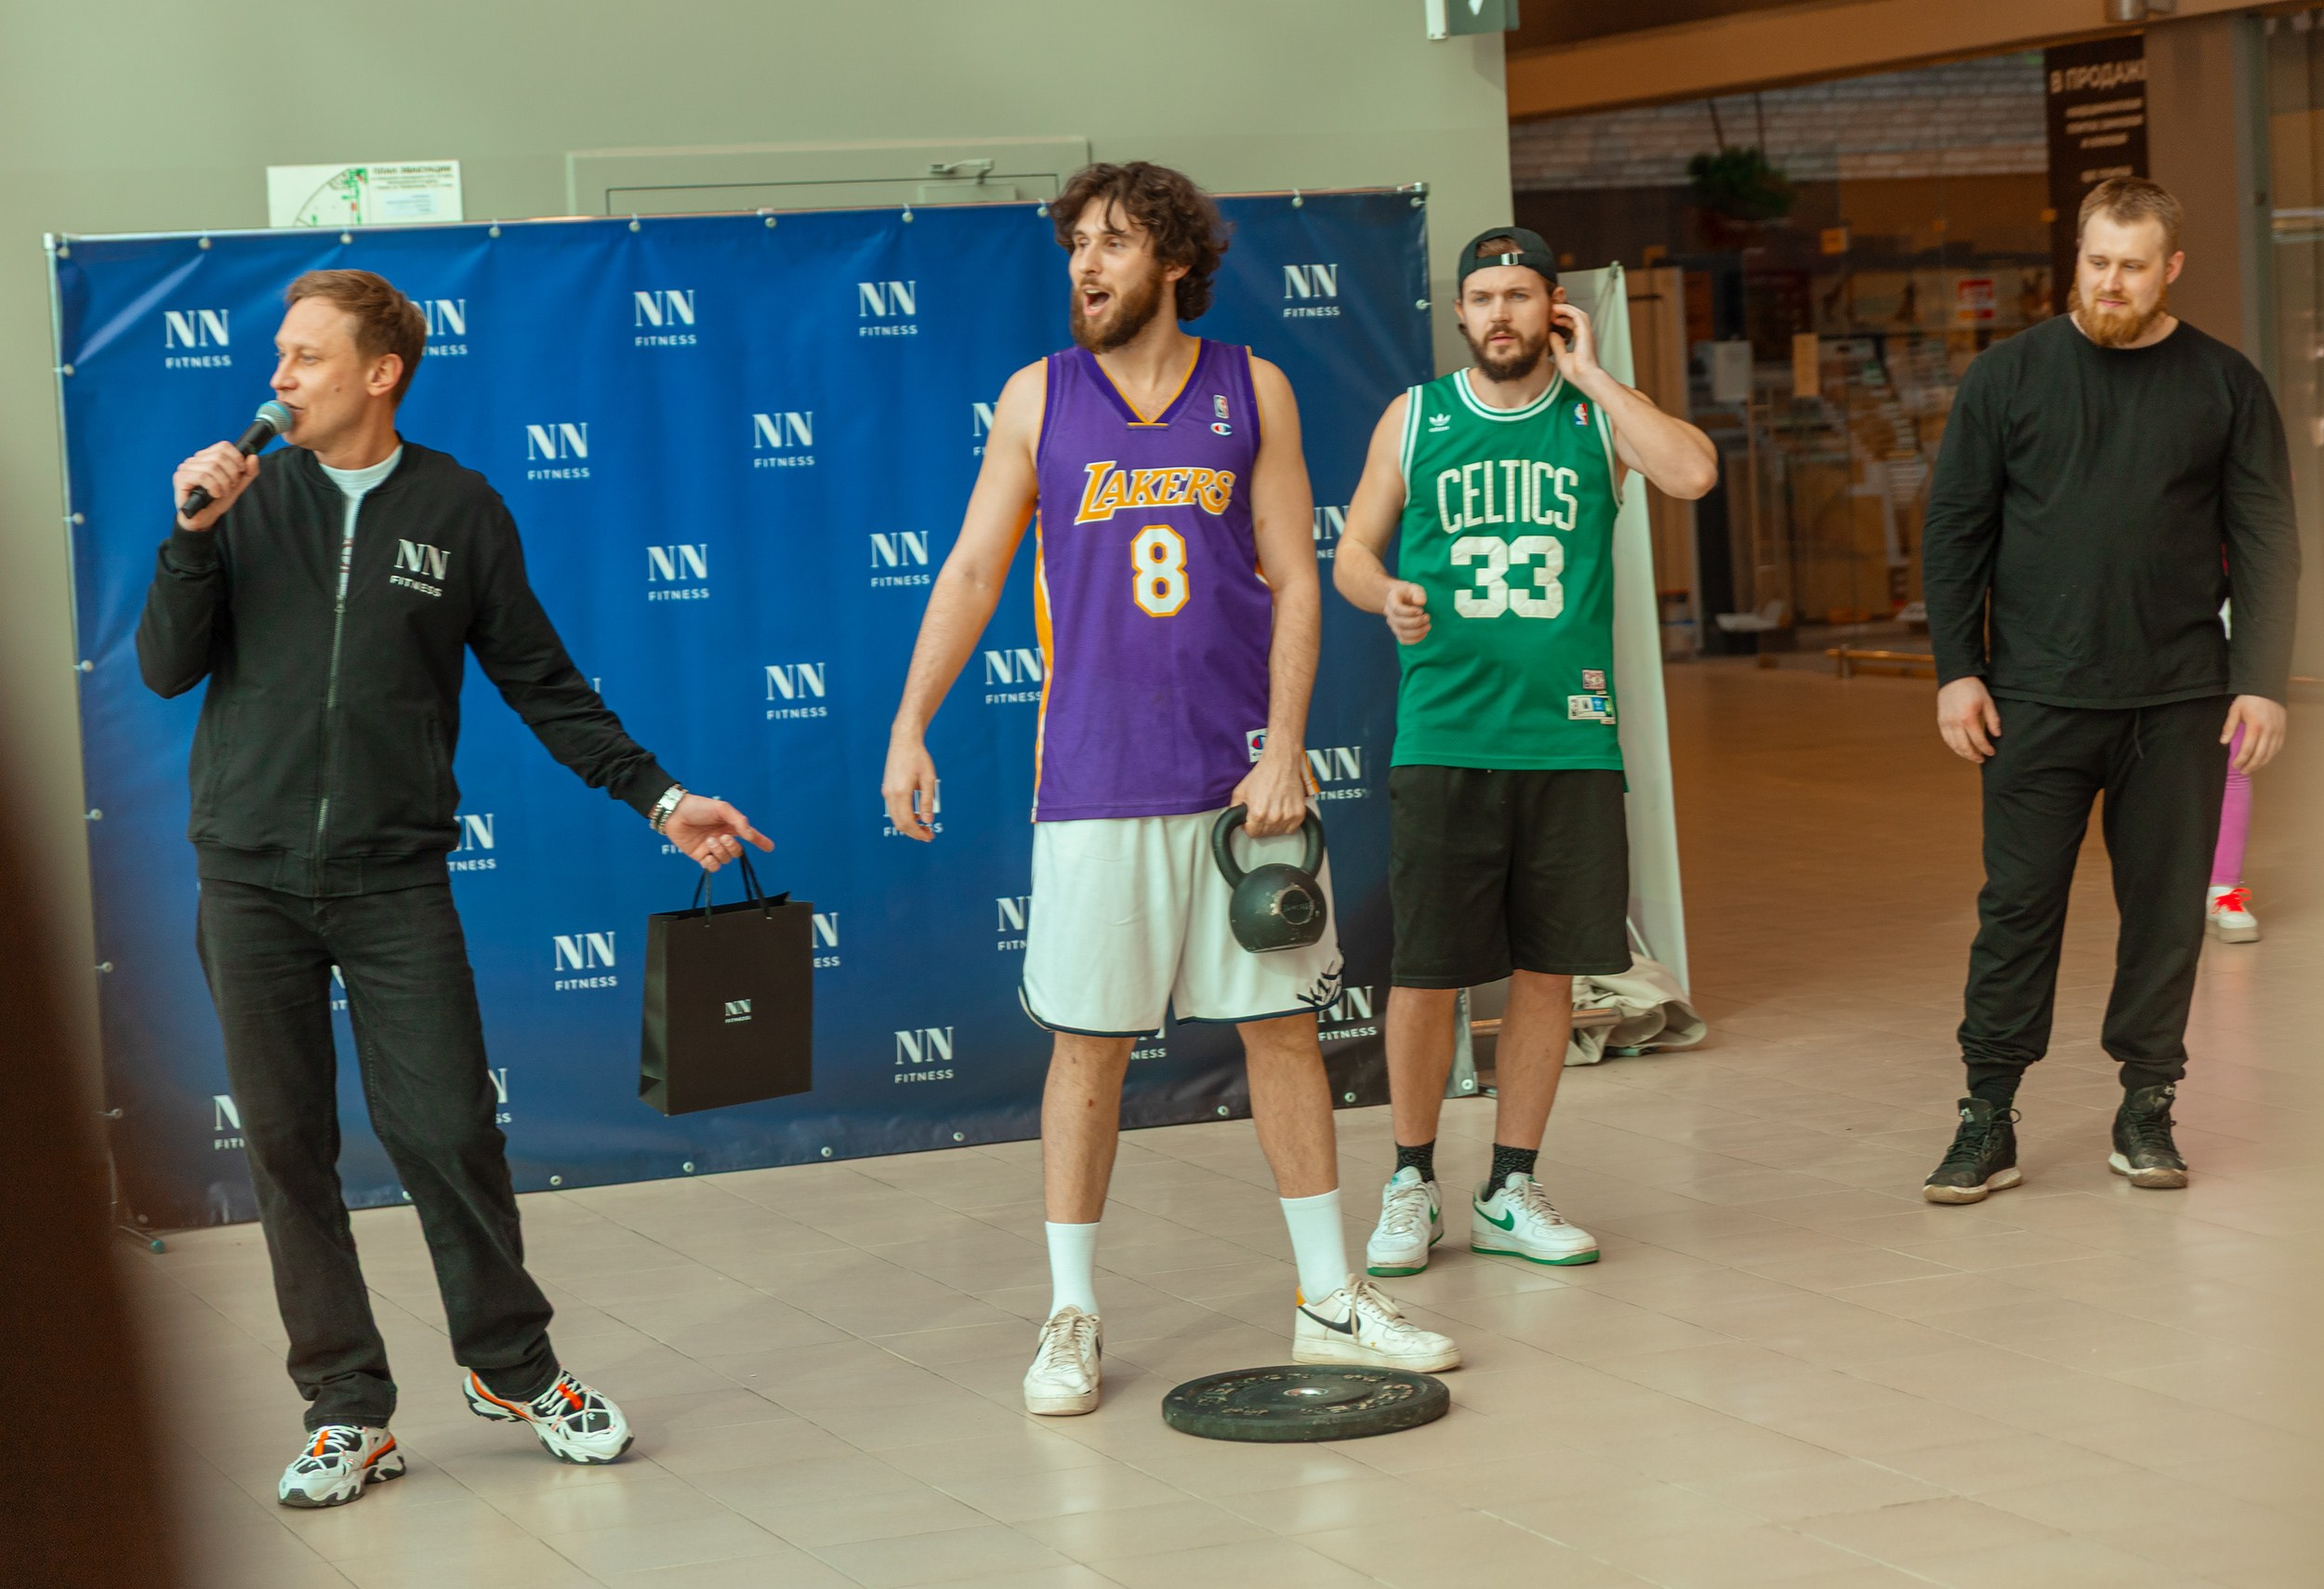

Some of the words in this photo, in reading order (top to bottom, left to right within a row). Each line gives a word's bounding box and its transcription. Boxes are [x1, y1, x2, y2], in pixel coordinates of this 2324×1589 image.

[2051, 70, 2063, 93] В
[858, 279, 917, 317] NN
[1283, 263, 1339, 298] NN
[634, 288, 695, 326] NN
[1284, 306, 1341, 318] FITNESS
[164, 308, 230, 349] NN
[635, 334, 697, 347] FITNESS
[860, 324, 918, 336] FITNESS
[165, 354, 232, 369] FITNESS
[526, 422, 588, 461] NN
[753, 410, 813, 448] NN
[528, 467, 590, 481] FITNESS
[754, 455, 815, 469] FITNESS
[1074, 460, 1236, 525] LAKERS
[1437, 459, 1578, 534] CELTICS
[393, 538, 452, 580] NN
[647, 544, 708, 582] NN
[869, 530, 929, 569] NN
[390, 575, 442, 597] FITNESS
[871, 574, 931, 588] FITNESS
[1130, 523, 1190, 617] 8
[1450, 536, 1564, 618] 33
[648, 588, 710, 602] FITNESS
[764, 661, 826, 701] NN
[984, 647, 1041, 685] NN
[766, 706, 827, 721] FITNESS
[1305, 746, 1361, 781] NN
[553, 931, 615, 972] NN
[555, 974, 618, 991] FITNESS
[724, 999, 752, 1016] NN
[894, 1026, 954, 1066] NN
[1318, 1026, 1377, 1041] FITNESS
[895, 1069, 955, 1084] FITNESS
